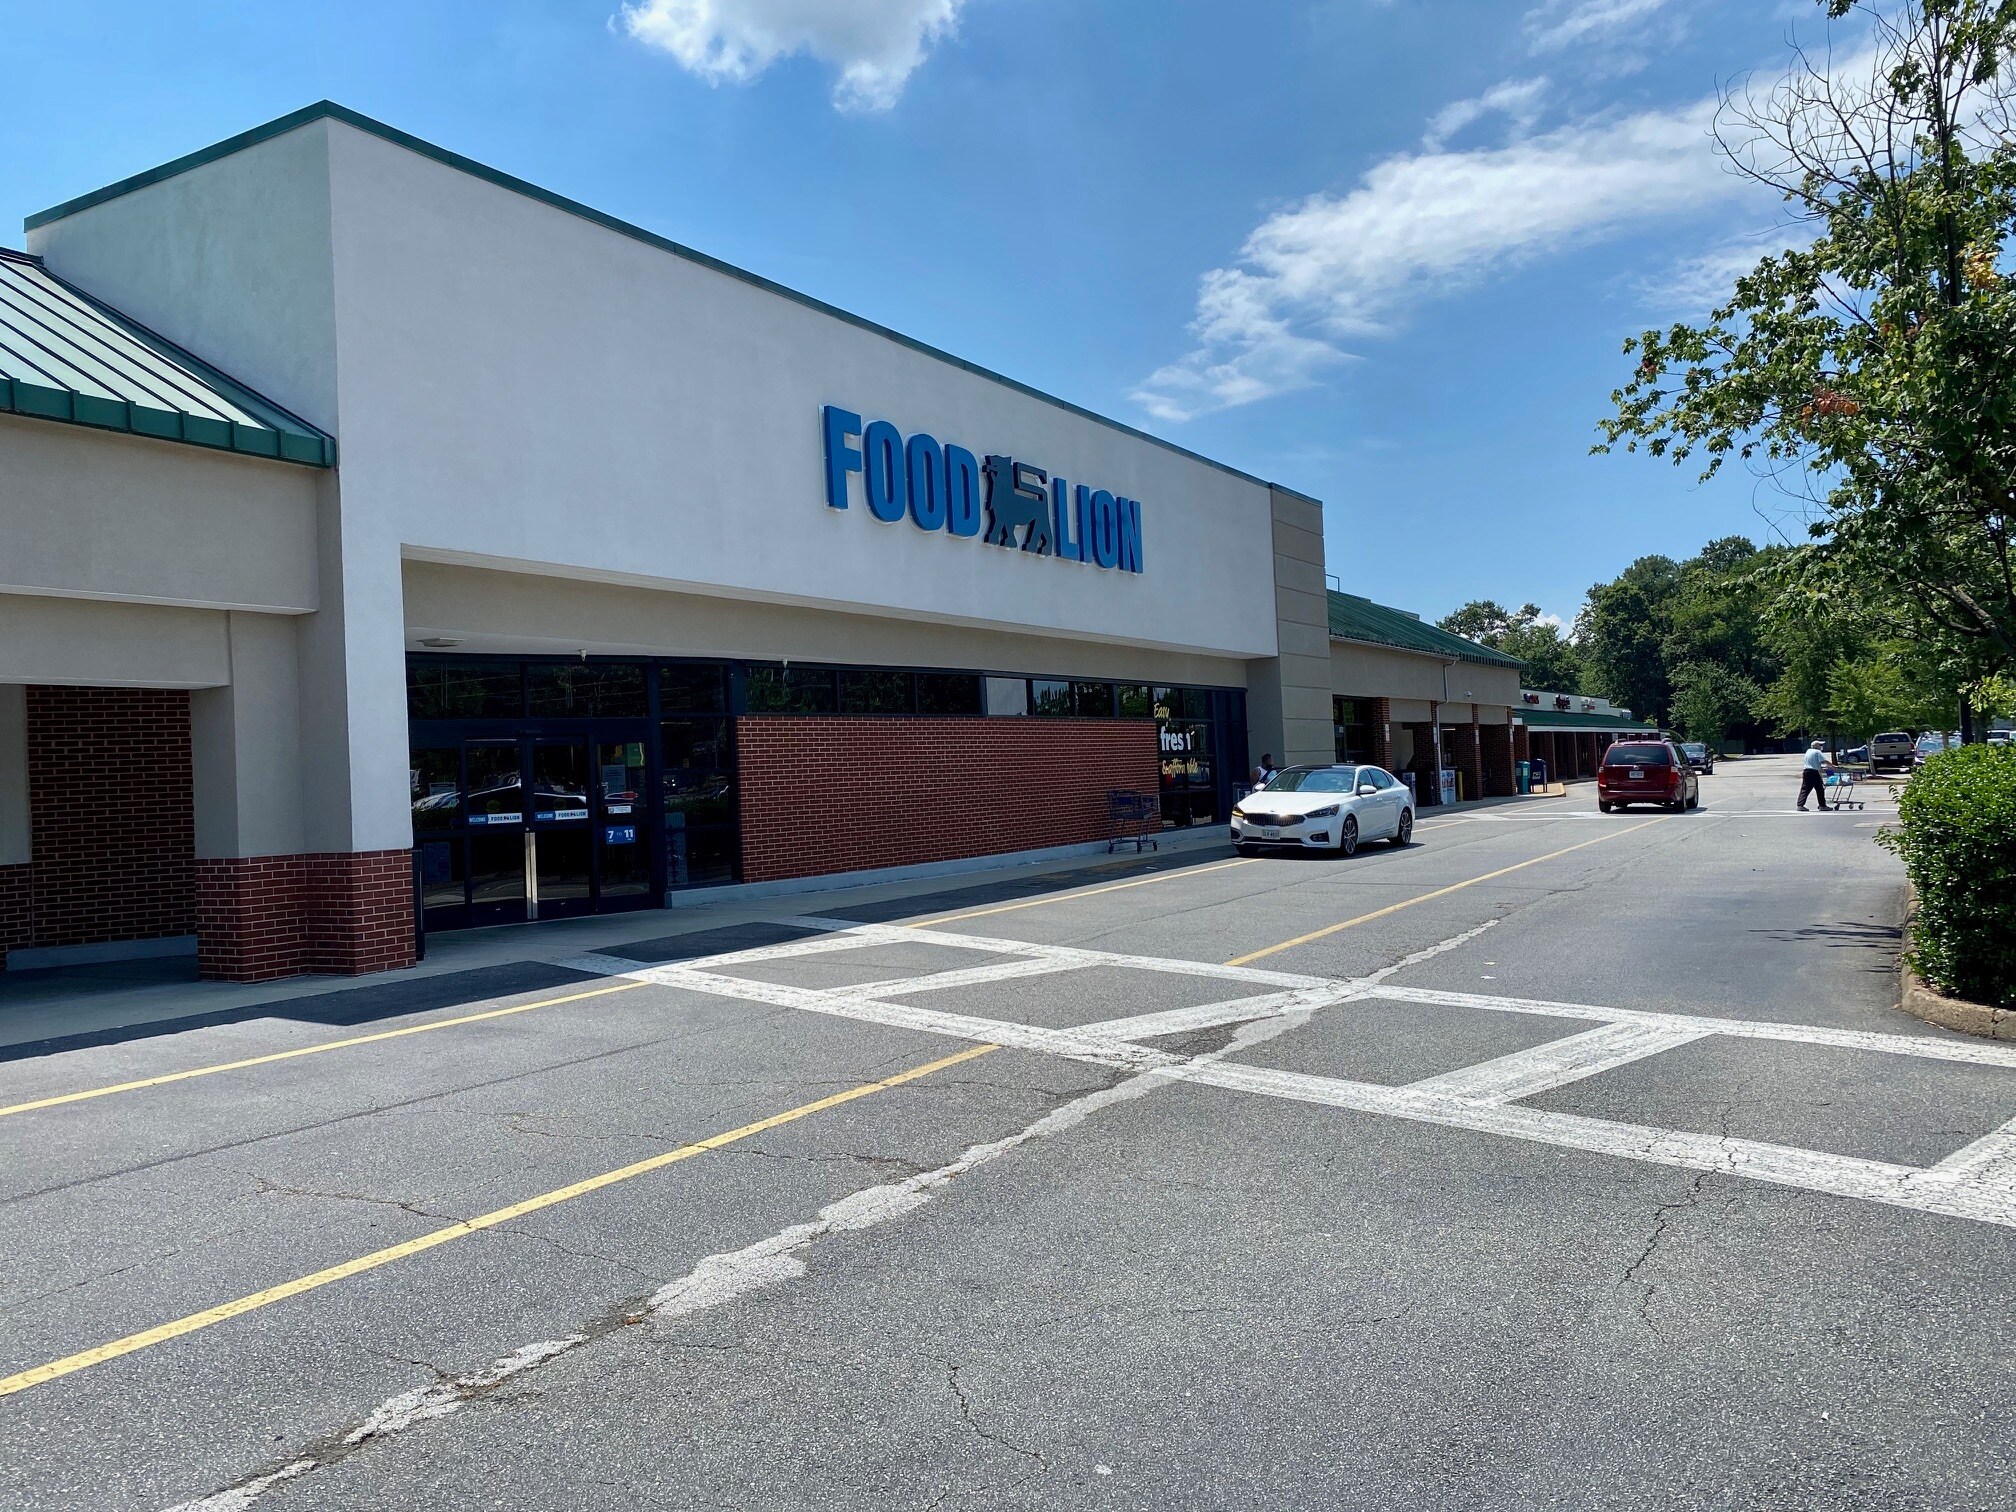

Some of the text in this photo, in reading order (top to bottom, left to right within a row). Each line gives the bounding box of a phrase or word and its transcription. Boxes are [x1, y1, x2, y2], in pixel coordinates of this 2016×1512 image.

[821, 405, 1144, 574] FOOD LION
[607, 830, 614, 839] 7
[624, 829, 634, 838] 11
